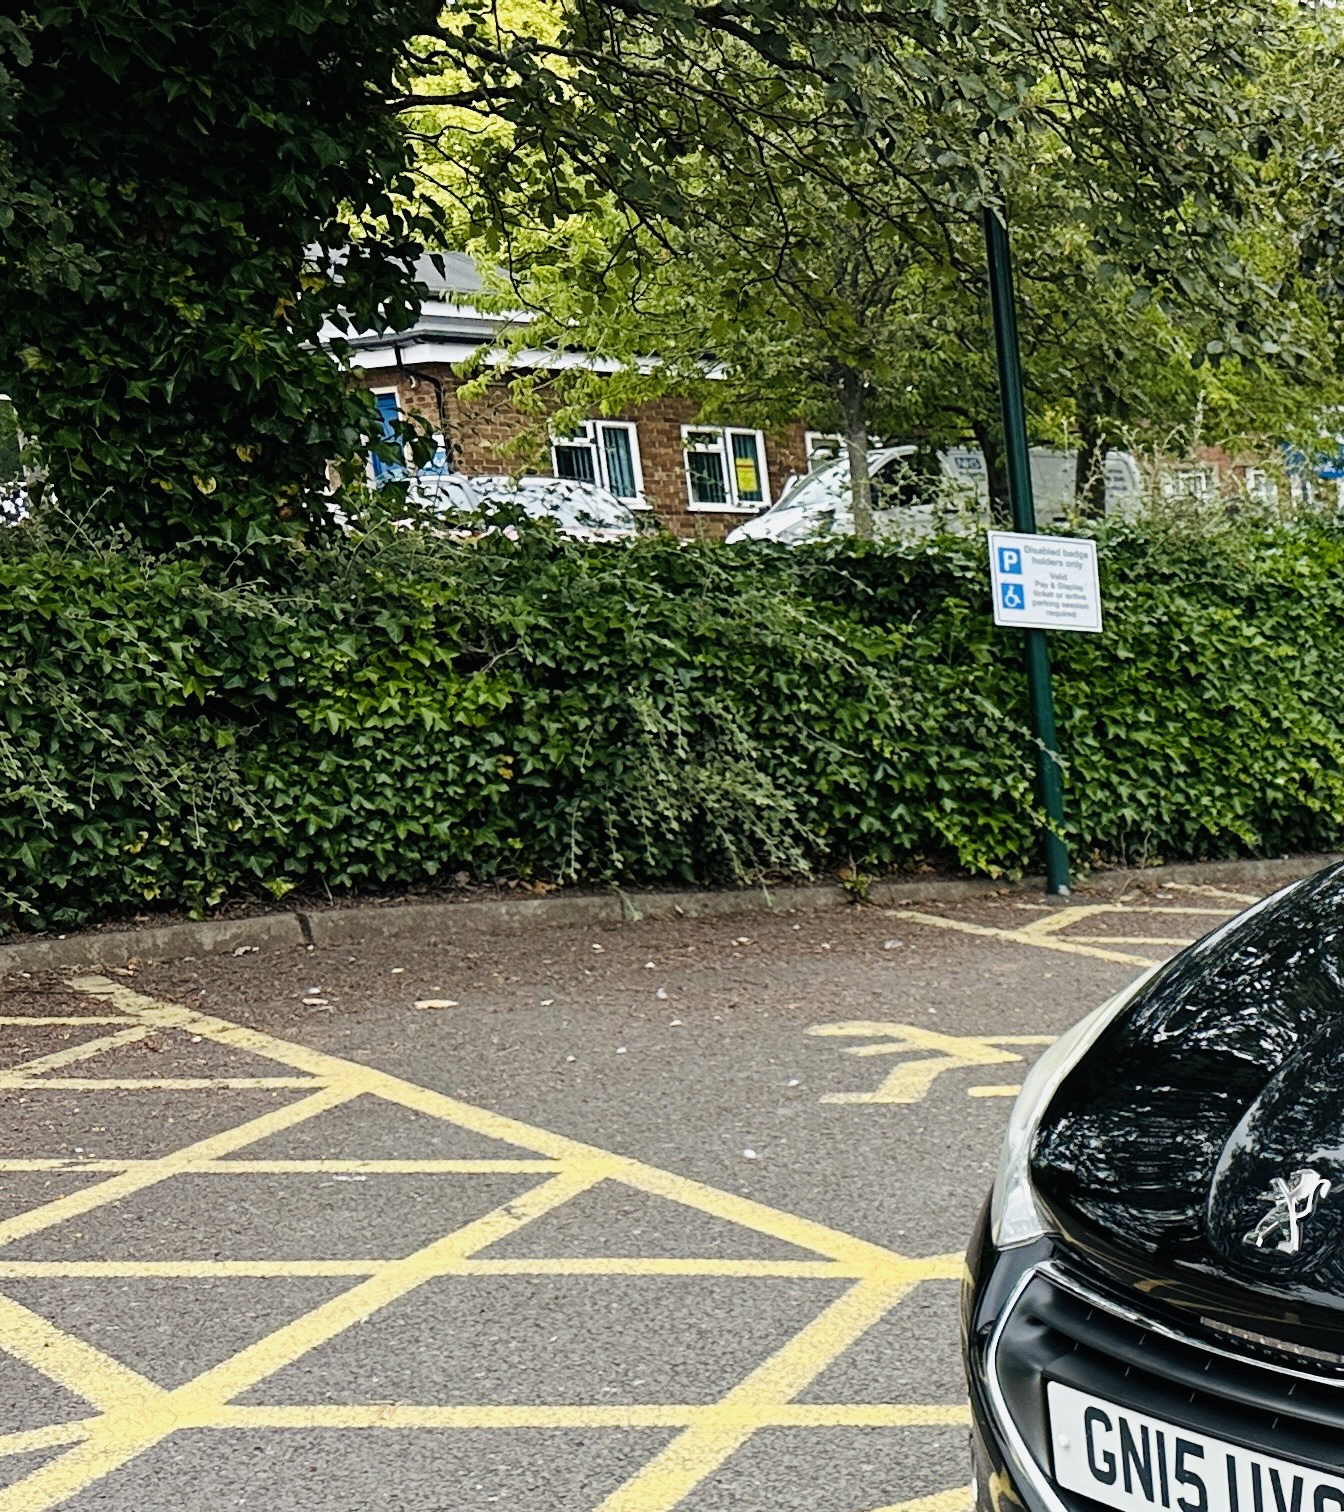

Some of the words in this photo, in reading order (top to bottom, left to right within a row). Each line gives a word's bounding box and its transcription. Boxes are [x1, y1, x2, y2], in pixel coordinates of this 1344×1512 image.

[1024, 545, 1061, 557] Disabled
[1063, 548, 1088, 560] badge
[1003, 551, 1018, 572] P
[1031, 556, 1063, 567] holders
[1065, 560, 1083, 570] only
[1034, 580, 1048, 590] Pay
[1057, 583, 1084, 593] Display
